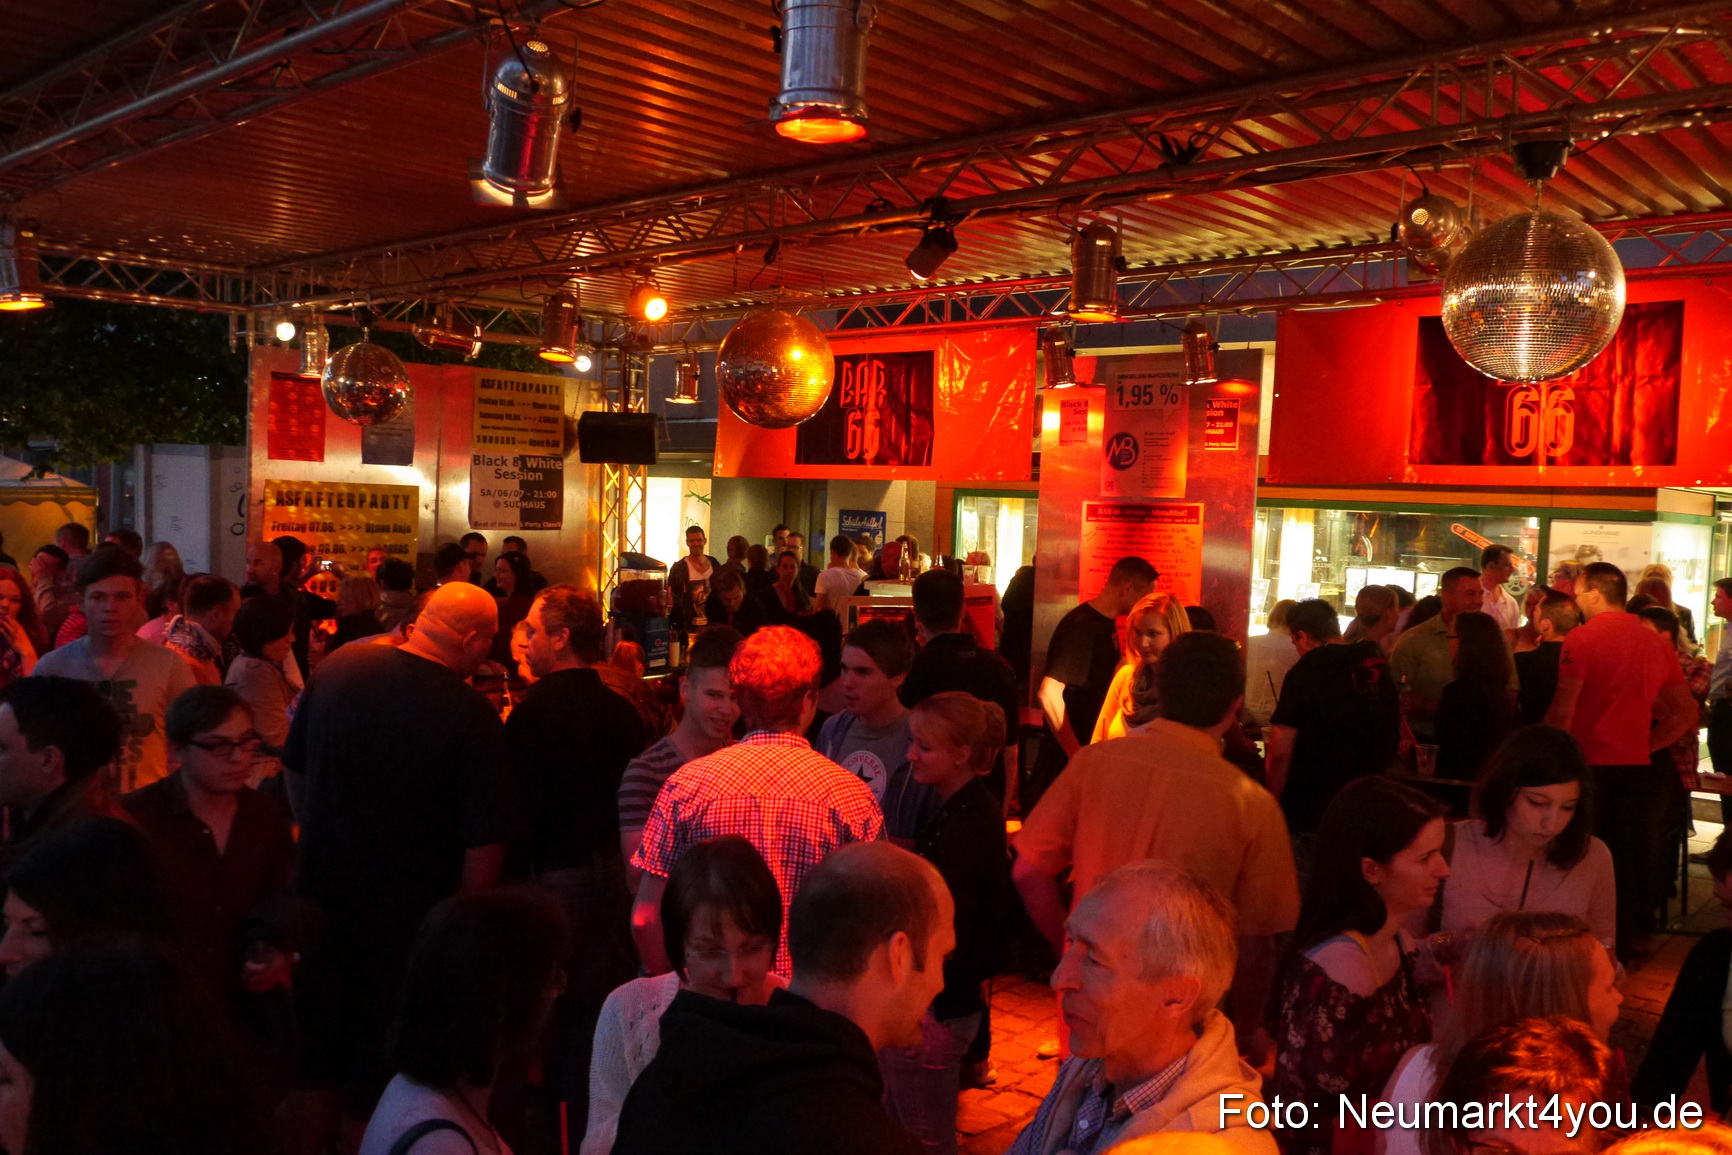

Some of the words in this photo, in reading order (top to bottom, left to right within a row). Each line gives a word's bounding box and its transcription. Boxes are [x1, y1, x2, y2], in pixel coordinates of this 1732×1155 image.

[840, 359, 888, 408] BAR
[1116, 384, 1154, 408] 1,95
[1160, 383, 1179, 406] %
[1505, 384, 1576, 457] 66
[844, 408, 881, 460] 66
[473, 454, 508, 467] Black
[526, 456, 563, 470] White
[494, 468, 544, 481] Session
[534, 490, 557, 499] 21:00
[271, 521, 306, 533] Freitag
